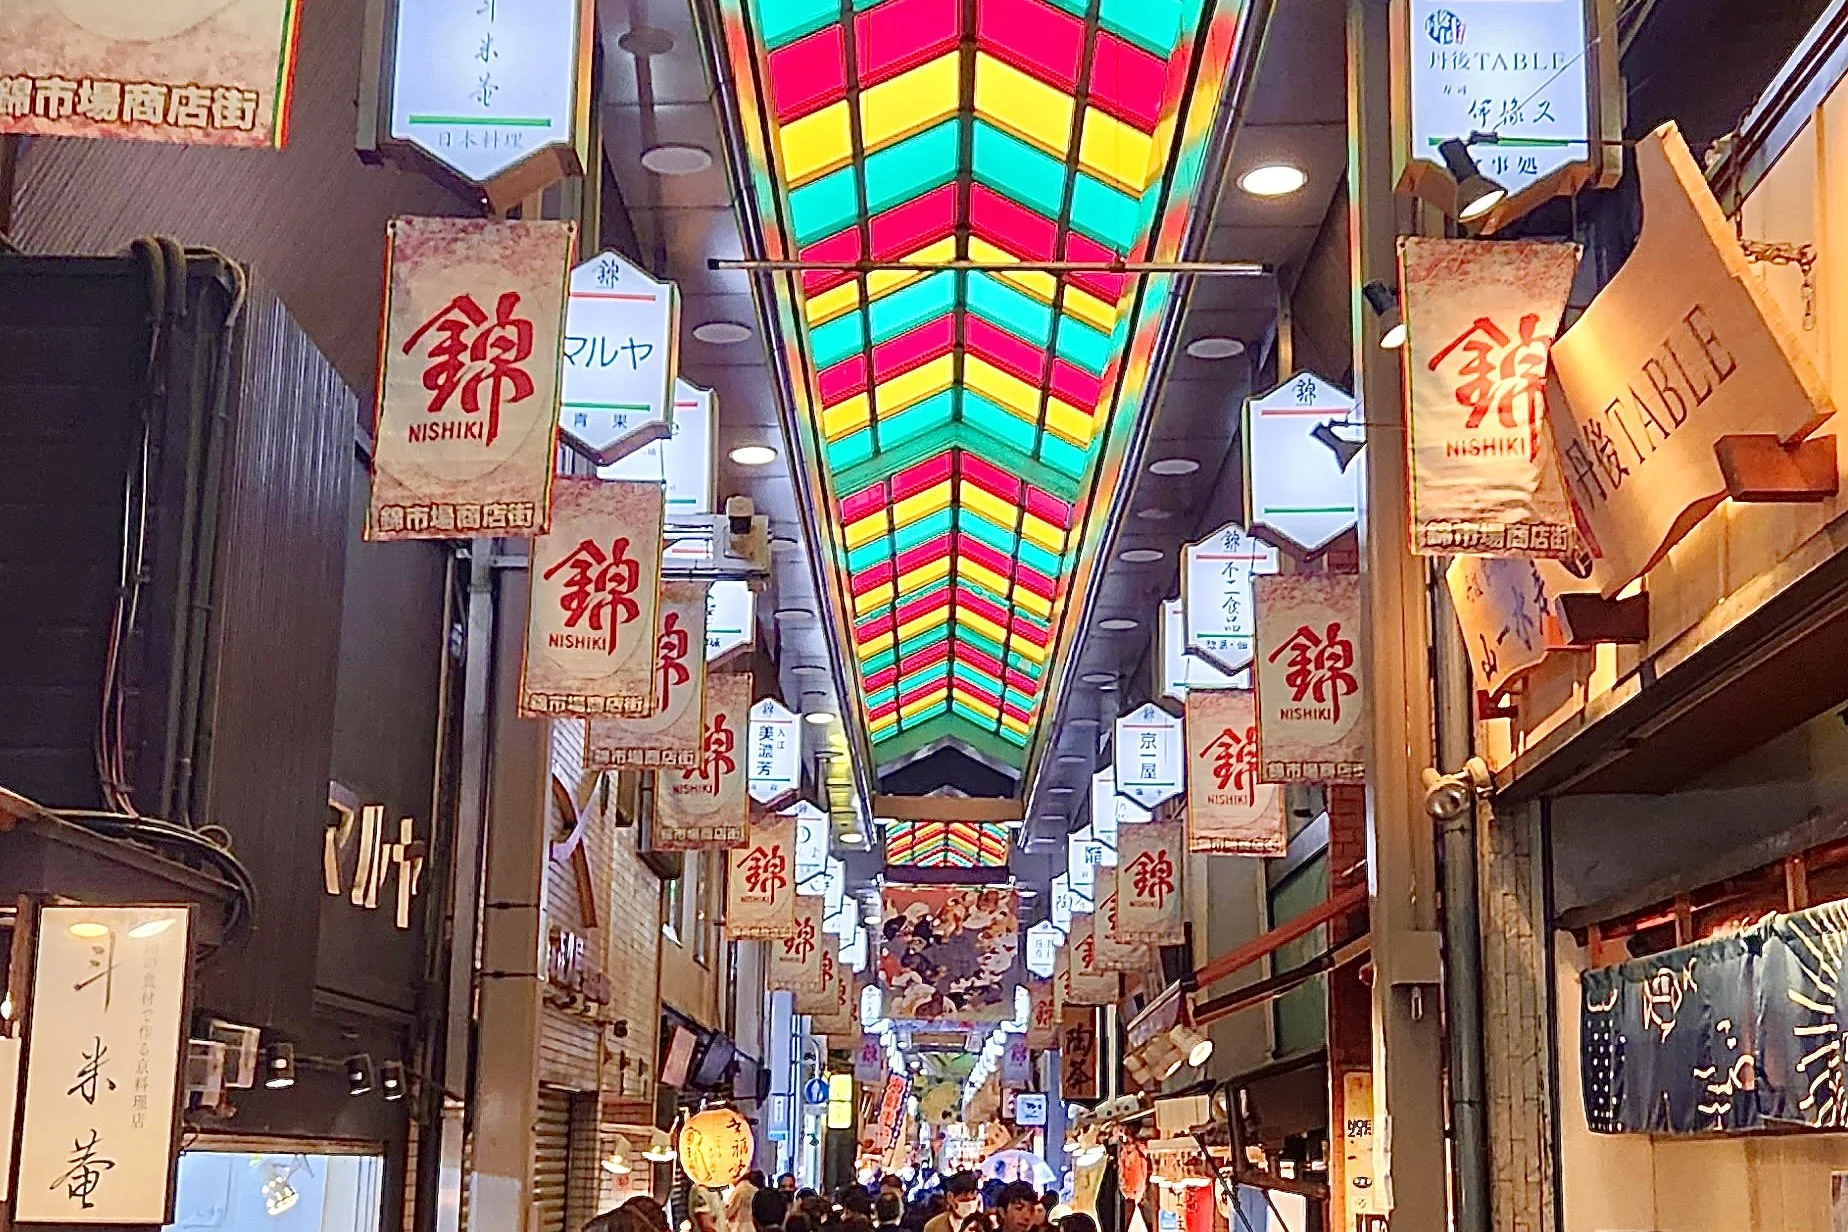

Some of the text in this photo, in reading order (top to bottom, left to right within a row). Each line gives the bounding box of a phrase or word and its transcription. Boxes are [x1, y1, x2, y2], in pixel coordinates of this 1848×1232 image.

[1429, 51, 1566, 71] 丹後TABLE
[438, 130, 524, 150] 日本料理
[402, 291, 535, 447] 錦
[563, 335, 653, 371] マルヤ
[1292, 378, 1317, 406] 錦
[1428, 313, 1548, 463] 錦
[1566, 303, 1737, 510] 丹後TABLE
[408, 420, 484, 444] NISHIKI
[1446, 437, 1526, 458] NISHIKI
[377, 501, 536, 534] 錦市場商店街
[543, 537, 640, 657] 錦
[1221, 561, 1242, 633] 不二食品
[548, 634, 606, 652] NISHIKI
[1268, 622, 1359, 725] 錦
[1280, 708, 1331, 721] NISHIKI
[1139, 732, 1157, 780] 京一屋
[1200, 725, 1258, 808] 錦
[673, 784, 713, 796] NISHIKI
[1208, 794, 1248, 806] NISHIKI
[737, 845, 787, 906] 錦
[1125, 849, 1175, 910] 錦
